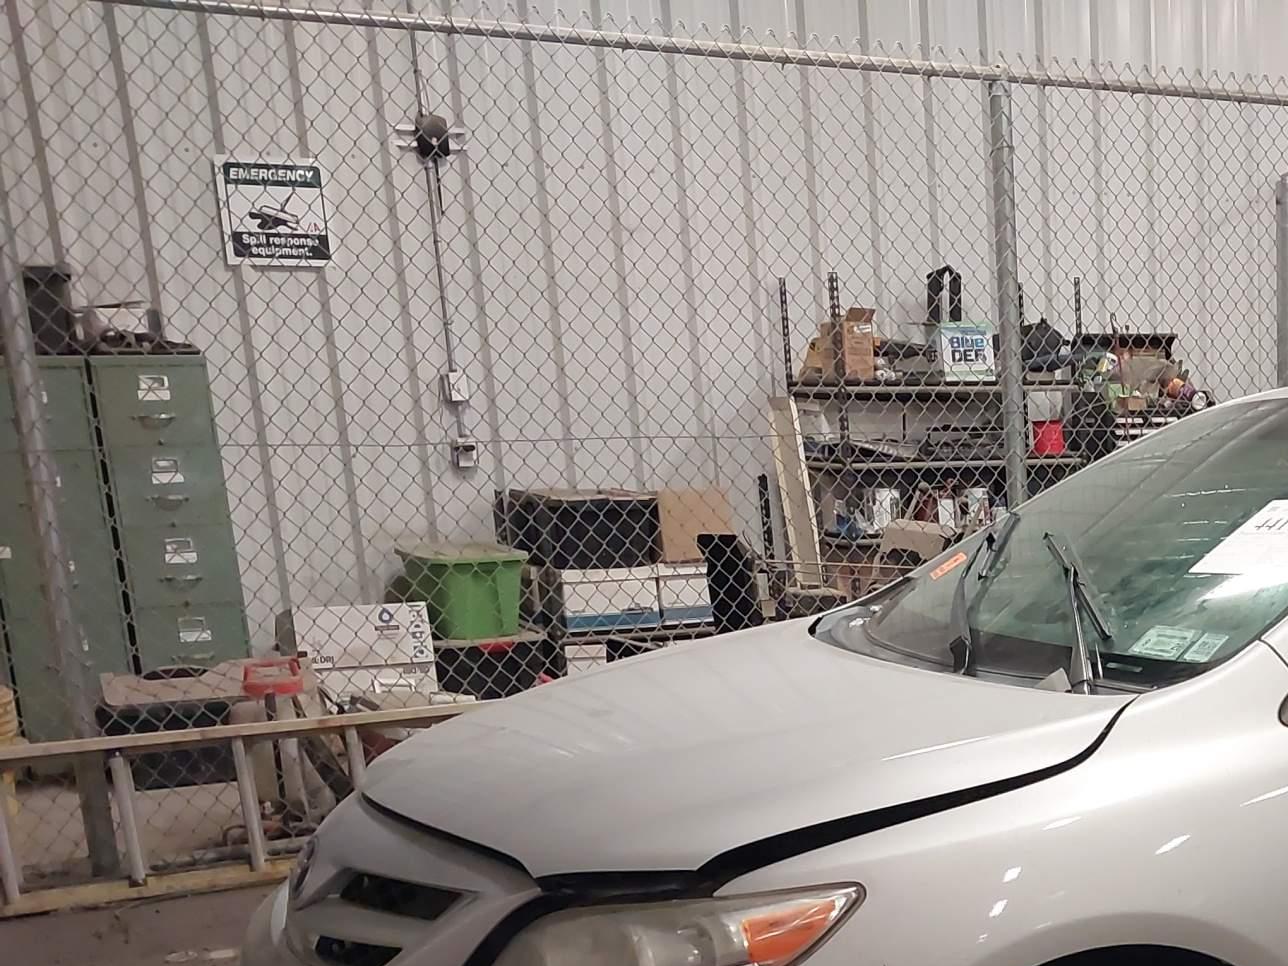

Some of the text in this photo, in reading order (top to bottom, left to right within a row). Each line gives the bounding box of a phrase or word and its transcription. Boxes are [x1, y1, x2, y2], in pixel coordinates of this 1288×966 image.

[229, 167, 314, 182] EMERGENCY
[241, 233, 320, 247] Spill response
